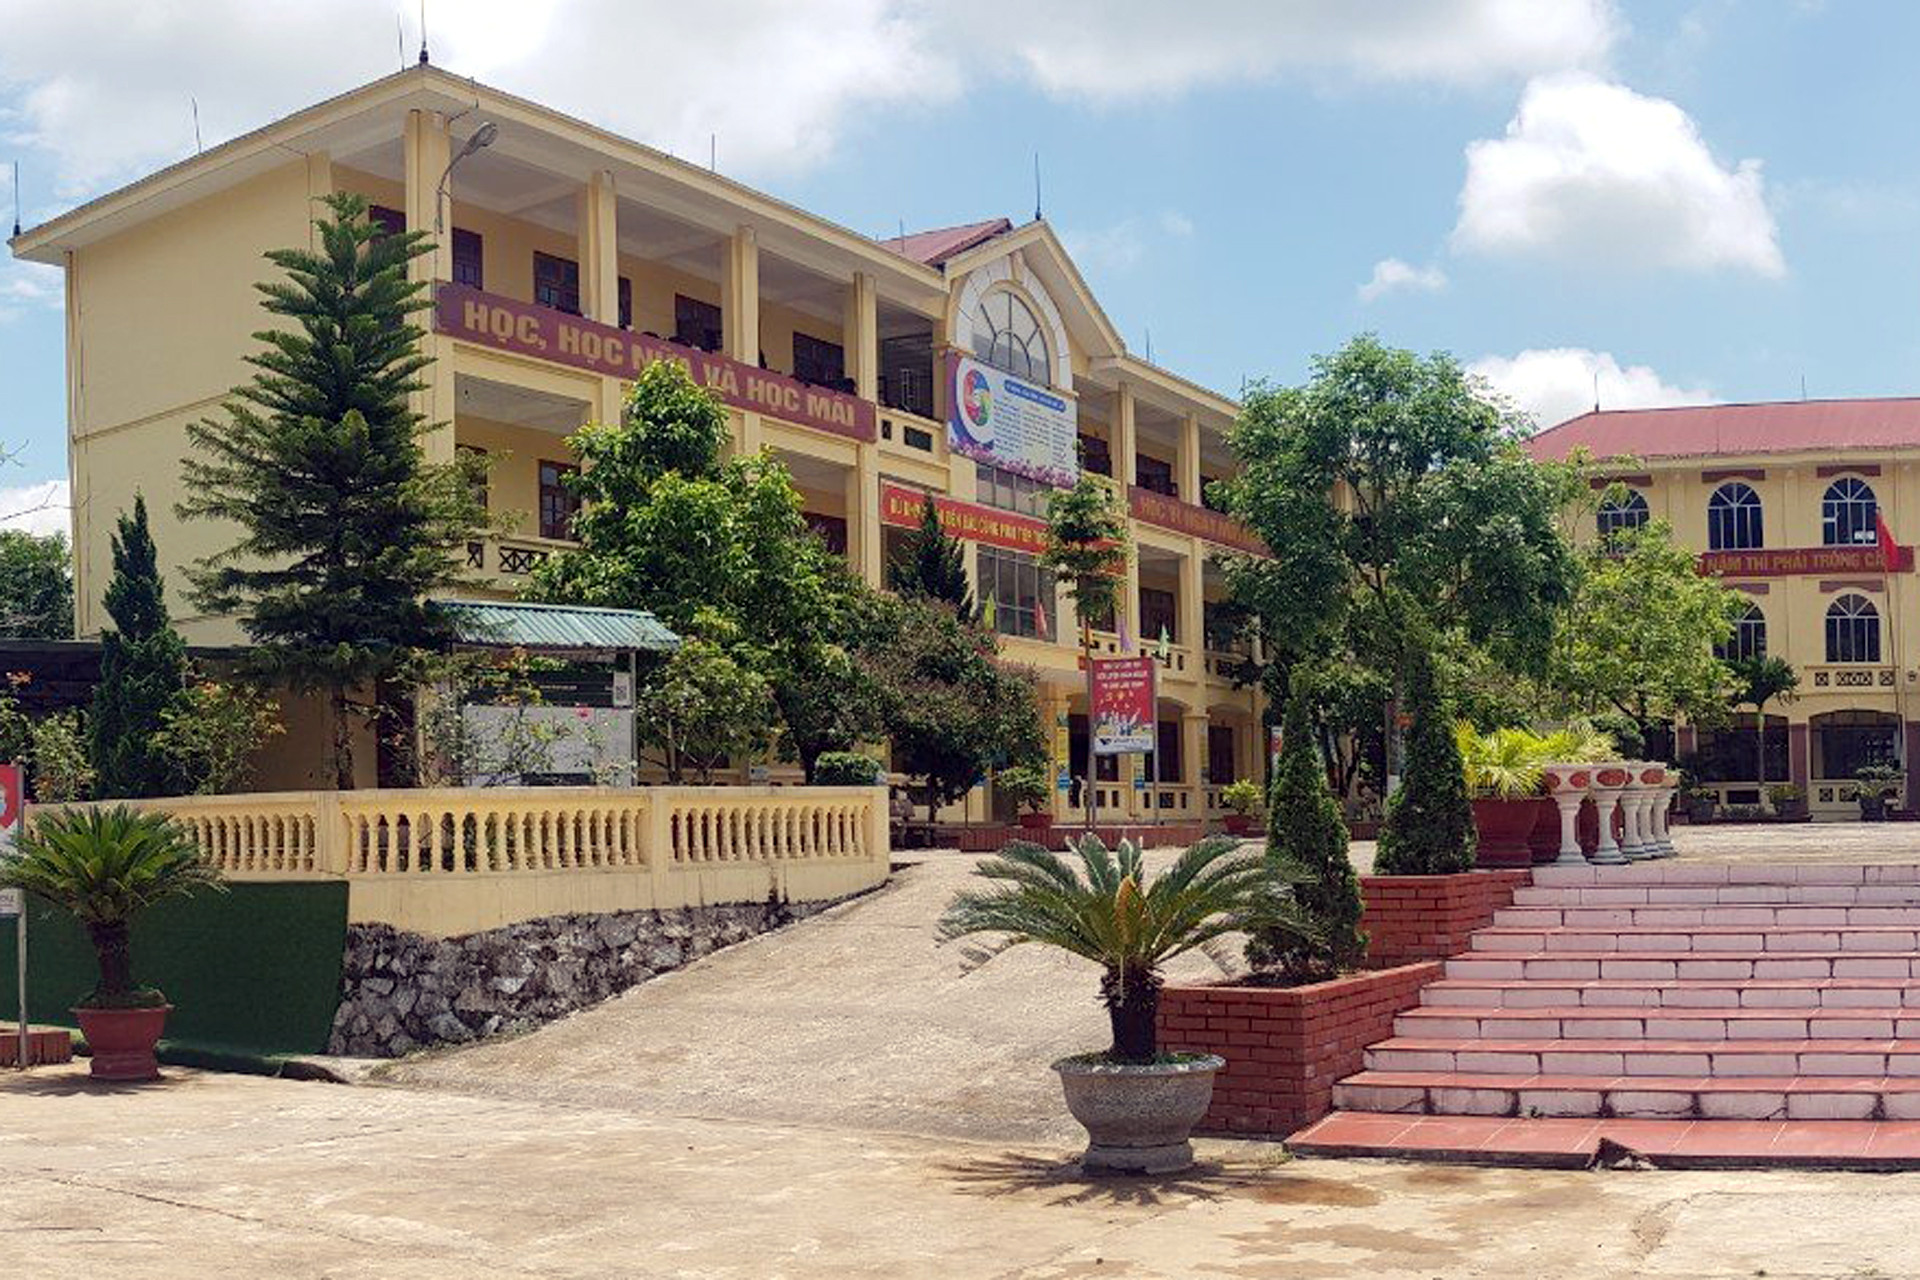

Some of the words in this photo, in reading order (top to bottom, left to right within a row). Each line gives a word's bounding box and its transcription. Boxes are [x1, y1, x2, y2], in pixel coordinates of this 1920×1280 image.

[463, 300, 548, 352] HỌC,
[558, 321, 624, 367] HỌC
[746, 375, 801, 413] HỌC
[806, 388, 856, 428] MÃI
[1865, 550, 1887, 567] CÂ
